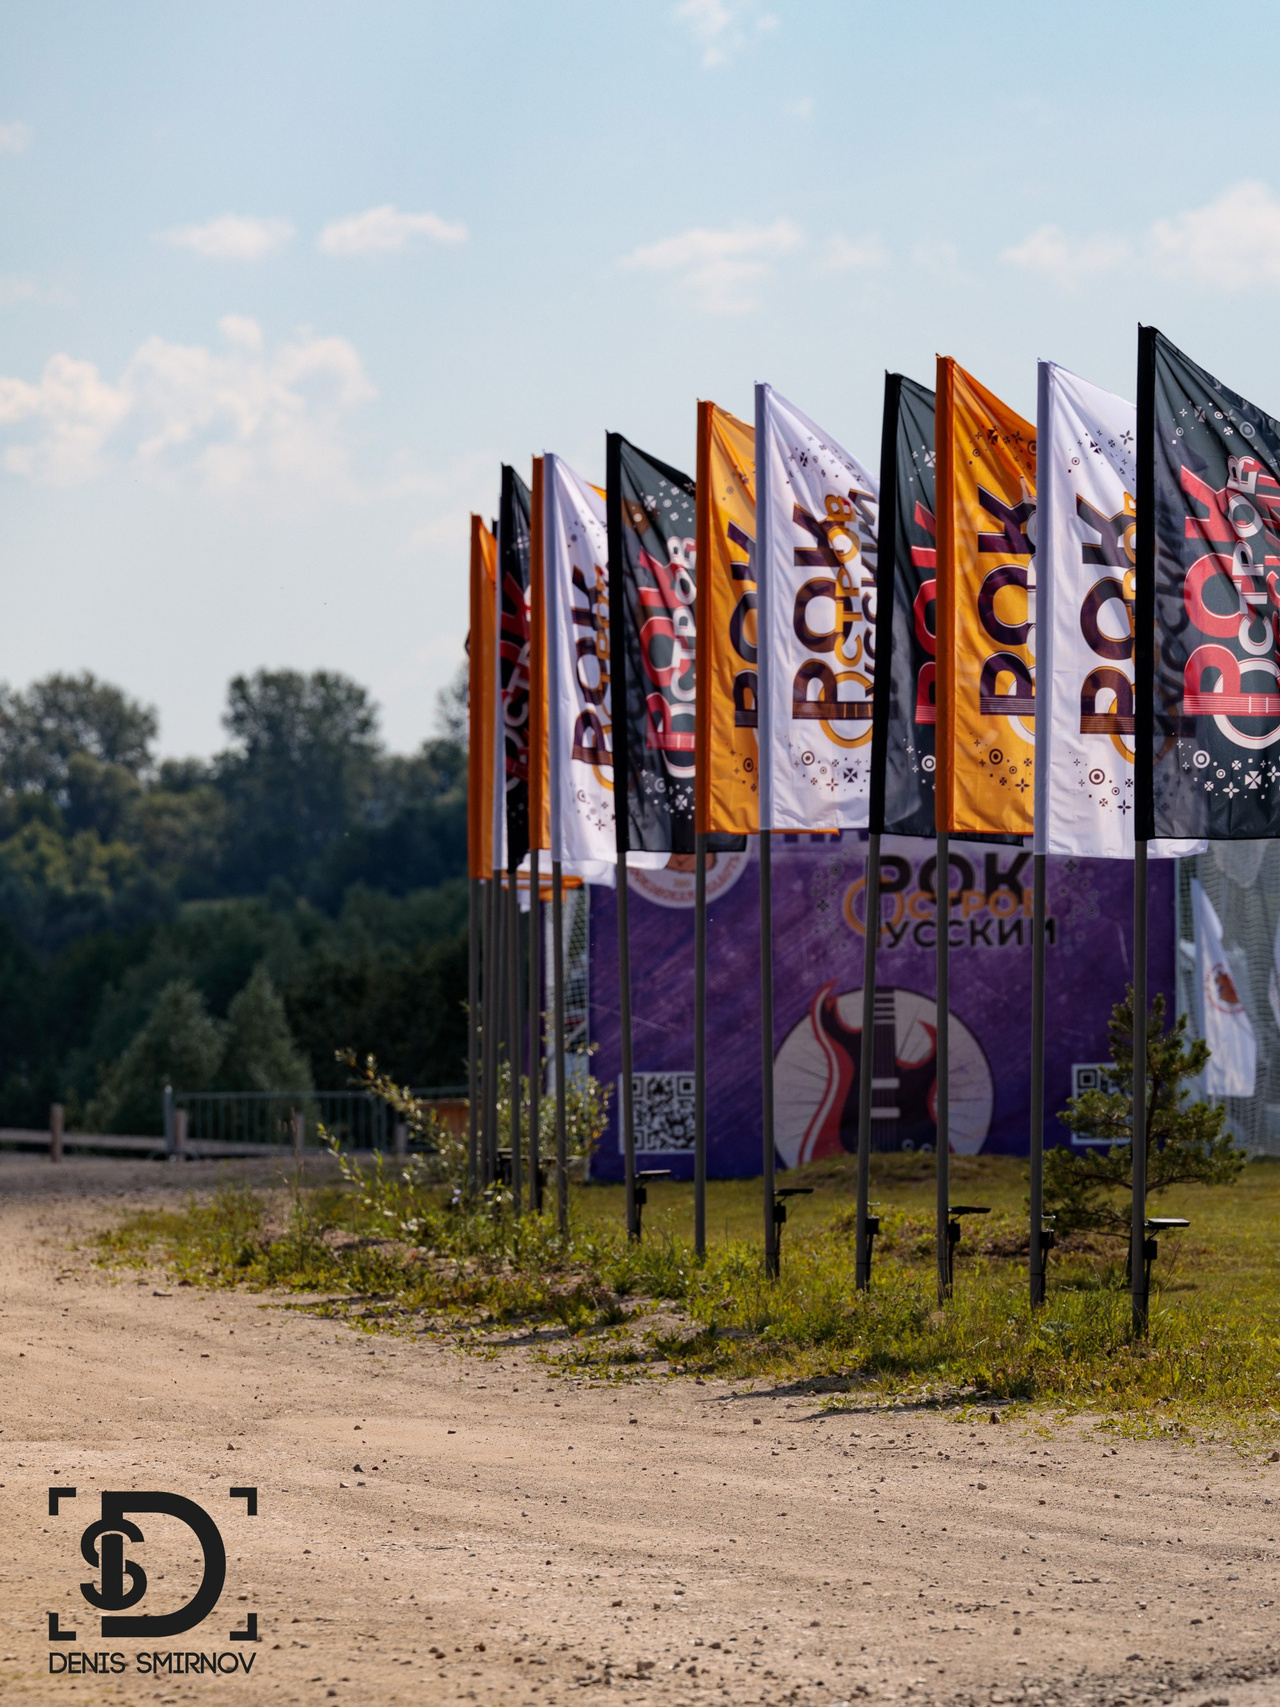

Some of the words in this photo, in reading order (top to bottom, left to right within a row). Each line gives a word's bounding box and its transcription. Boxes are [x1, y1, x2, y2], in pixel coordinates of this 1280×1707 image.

[638, 545, 695, 751] РОК
[793, 503, 873, 720] РОК
[977, 485, 1036, 716] РОК
[1076, 493, 1135, 735] РОК
[866, 852, 1035, 925] РОК
